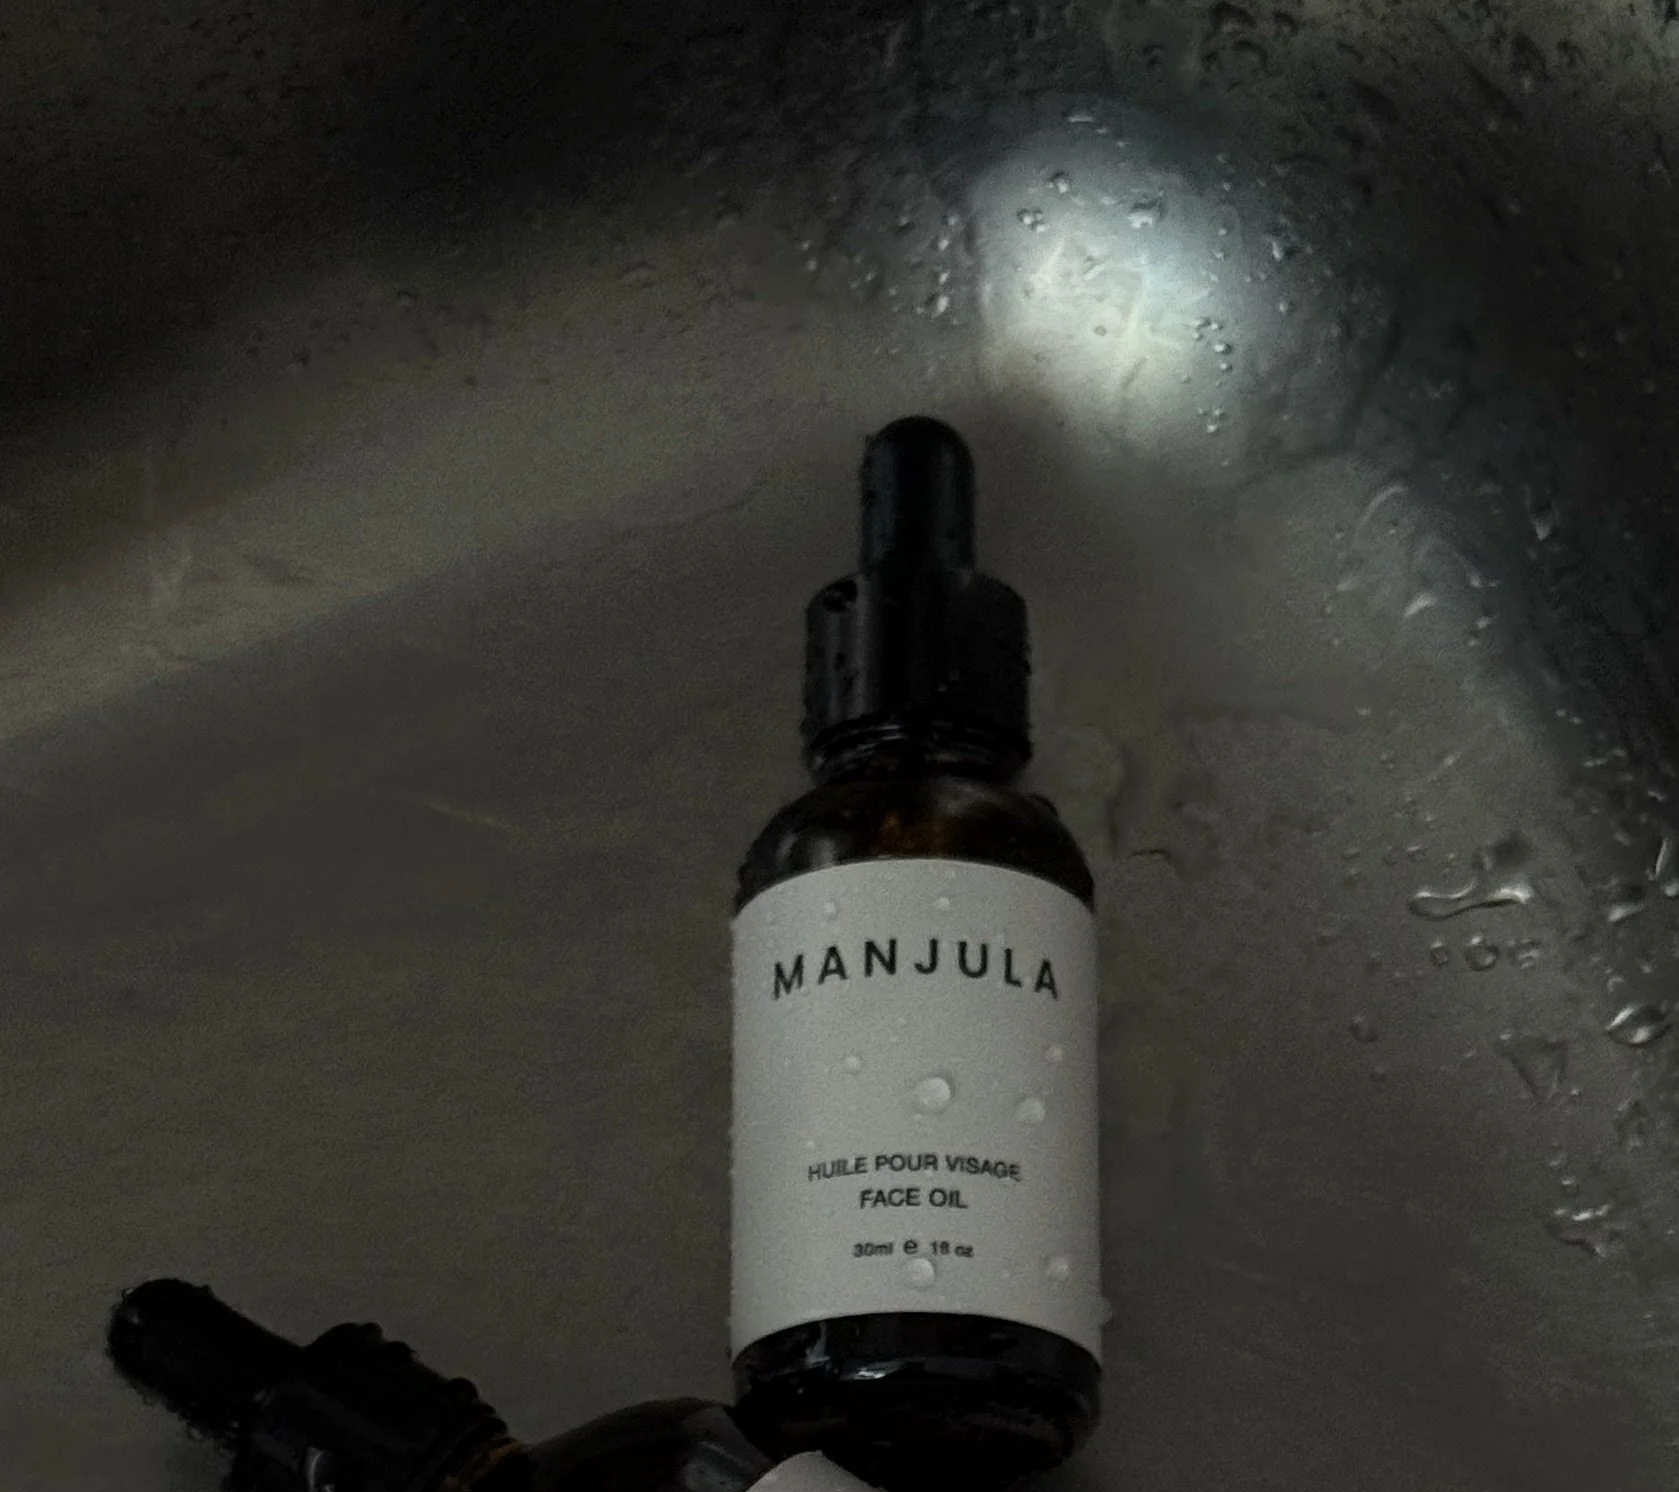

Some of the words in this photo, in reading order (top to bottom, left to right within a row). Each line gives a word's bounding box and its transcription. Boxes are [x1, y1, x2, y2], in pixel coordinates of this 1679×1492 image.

[774, 938, 1059, 1000] MANJULA
[808, 1155, 869, 1182] HUILE
[874, 1153, 938, 1172] POUR
[944, 1154, 1022, 1182] VISAGE
[859, 1187, 921, 1209] FACE
[928, 1188, 969, 1209] OIL
[852, 1241, 894, 1258] 30ml
